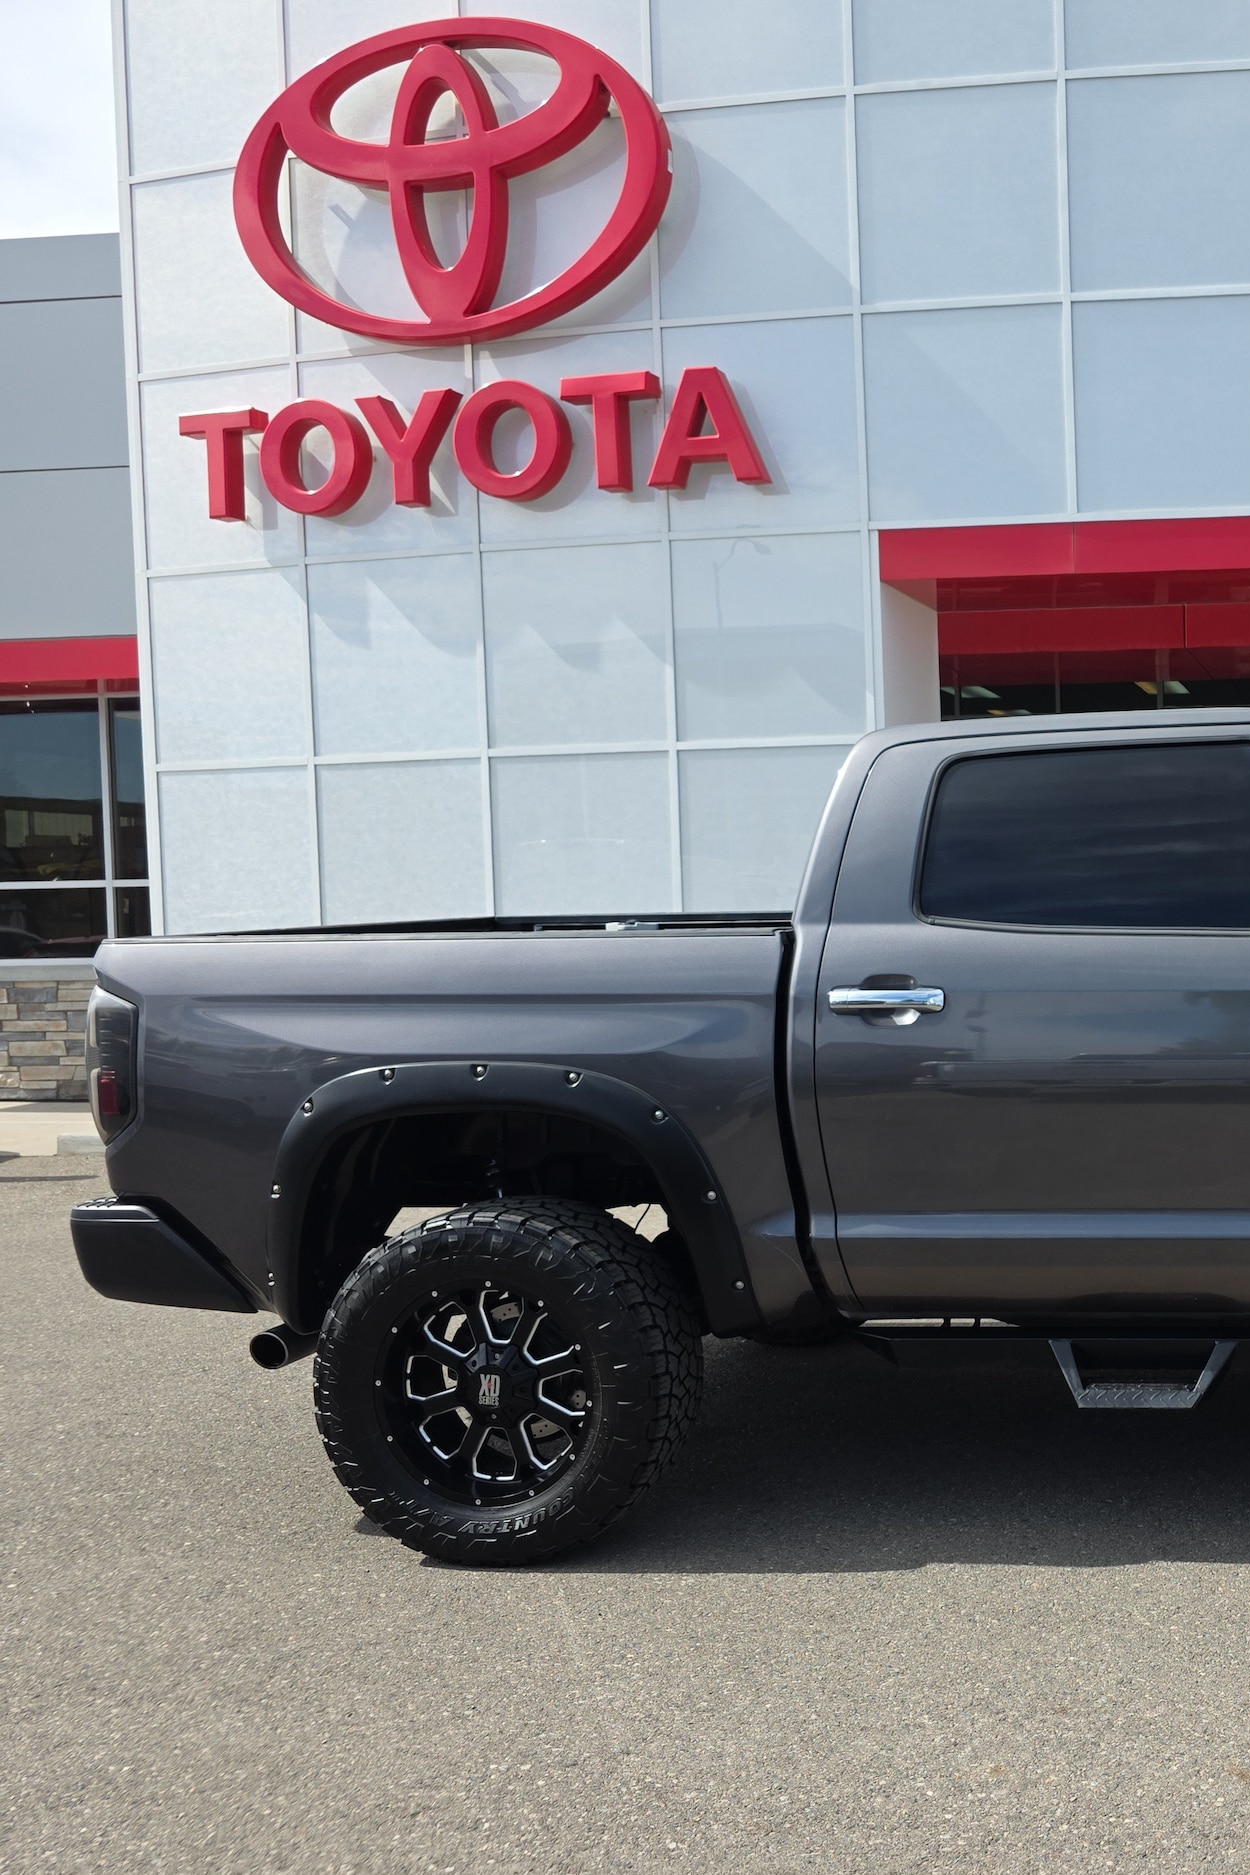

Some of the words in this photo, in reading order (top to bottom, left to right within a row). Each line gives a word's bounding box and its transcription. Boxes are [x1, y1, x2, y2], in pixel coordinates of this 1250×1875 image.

[178, 366, 773, 522] TOYOTA
[478, 1396, 500, 1406] SERIES
[479, 1373, 500, 1397] XD
[457, 1486, 575, 1535] COUNTRY
